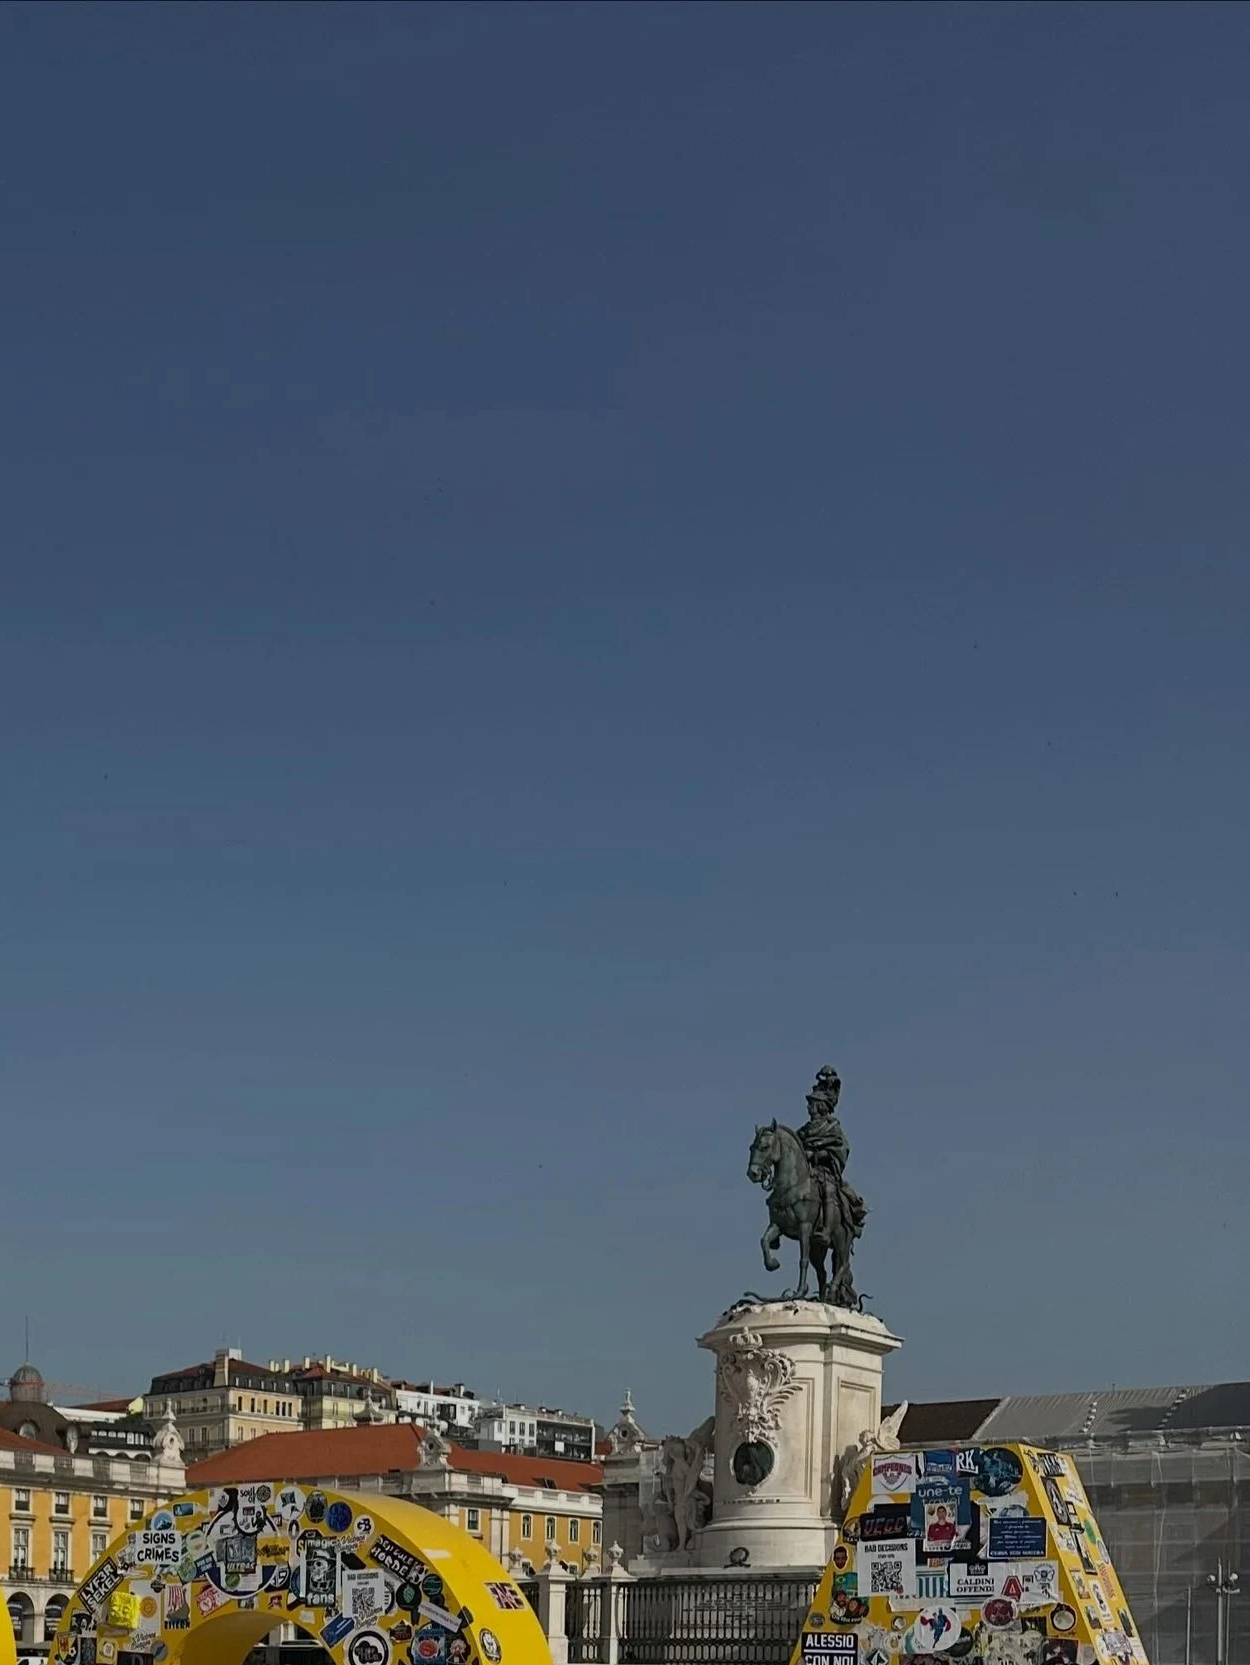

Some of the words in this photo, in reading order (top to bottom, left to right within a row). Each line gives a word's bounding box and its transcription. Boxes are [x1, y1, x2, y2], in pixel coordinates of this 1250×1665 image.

[918, 1484, 963, 1497] une-te
[142, 1532, 176, 1545] SIGNS
[137, 1547, 180, 1563] CRIMES
[865, 1544, 884, 1553] BAD
[885, 1542, 909, 1553] DECISIONS
[80, 1563, 115, 1599] LYF3R
[87, 1573, 120, 1611] SEKEL
[307, 1592, 335, 1606] fans
[805, 1633, 854, 1649] ALESSIO
